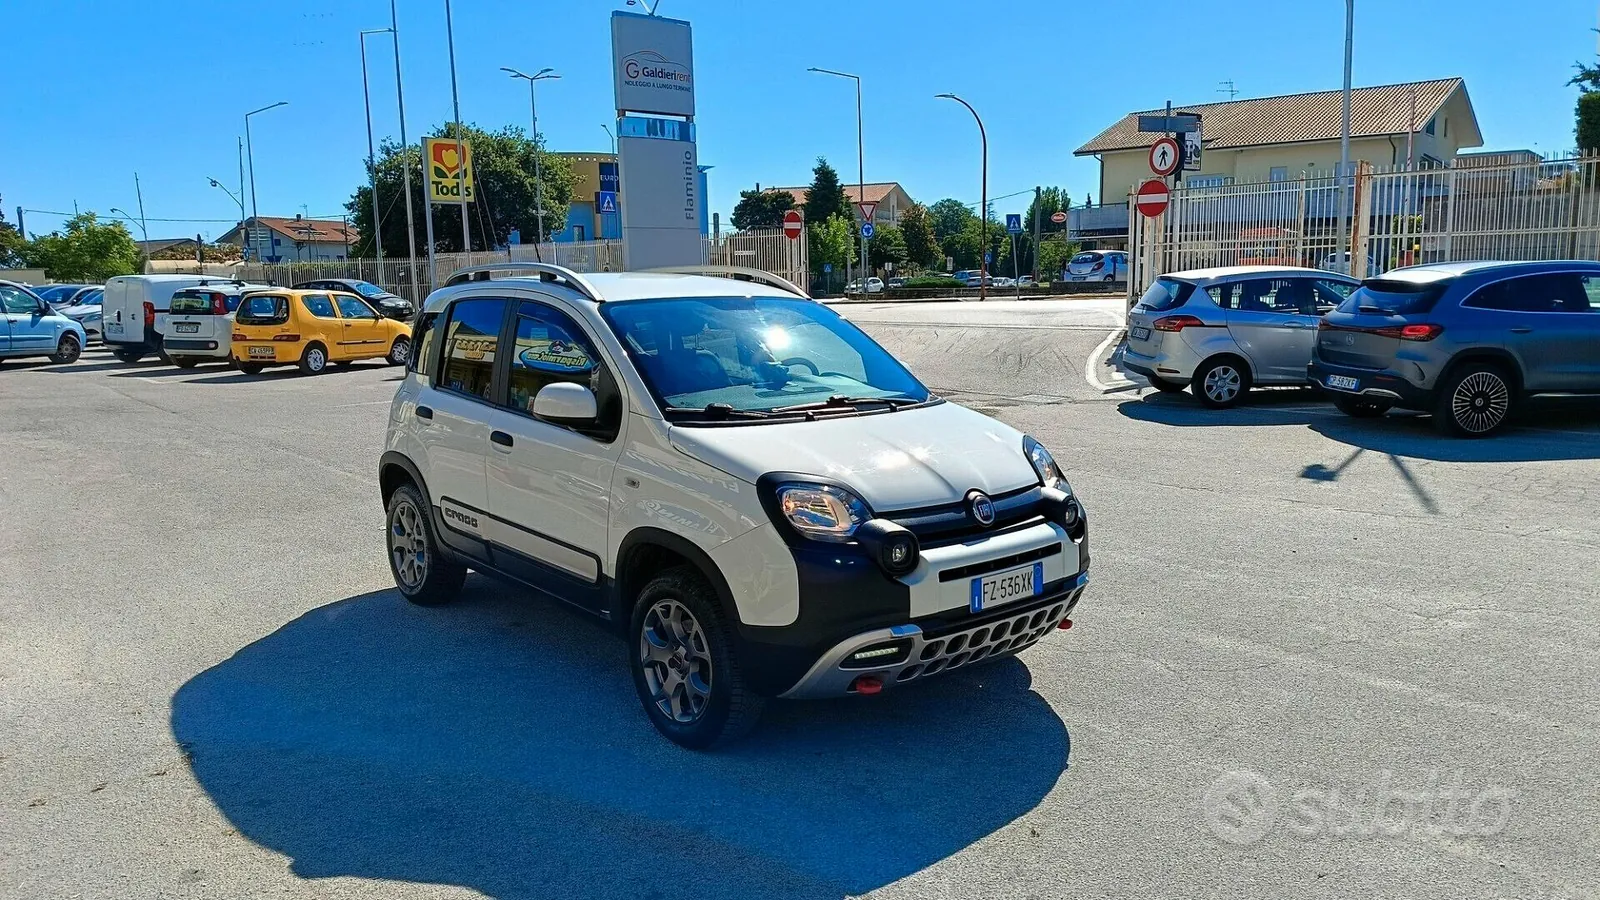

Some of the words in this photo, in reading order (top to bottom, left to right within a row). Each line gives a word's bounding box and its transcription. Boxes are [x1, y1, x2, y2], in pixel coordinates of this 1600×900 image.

[432, 181, 472, 197] Tods
[682, 150, 694, 220] Flaminio
[1000, 571, 1034, 598] 536XK
